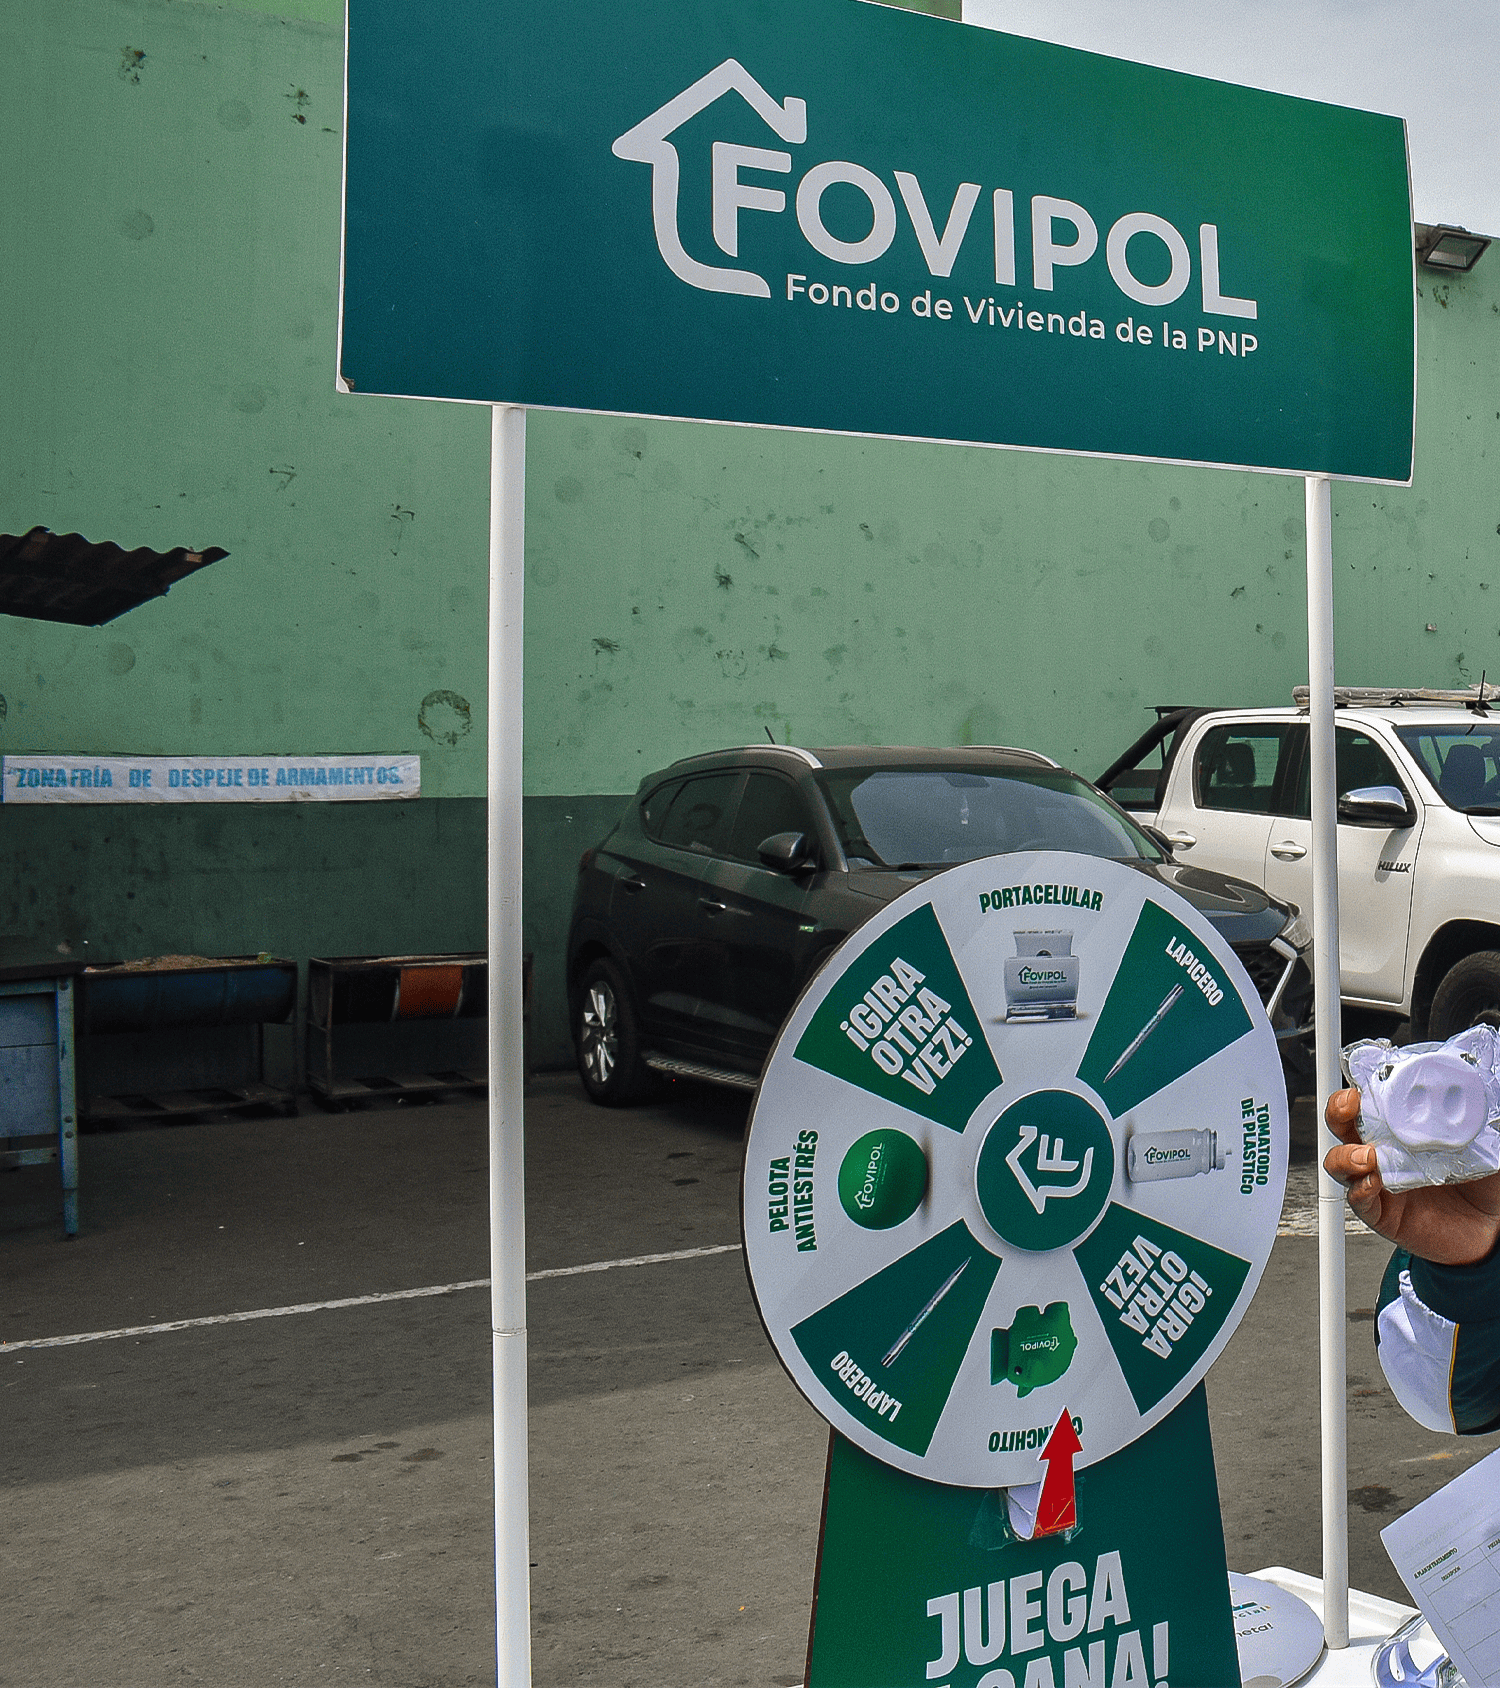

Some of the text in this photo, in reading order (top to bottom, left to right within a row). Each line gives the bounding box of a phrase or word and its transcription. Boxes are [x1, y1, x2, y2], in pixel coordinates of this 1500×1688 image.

[713, 141, 1258, 319] FOVIPOL
[786, 274, 1259, 358] Fondo de Vivienda de la PNP
[129, 769, 152, 787] DE
[168, 768, 243, 788] DESPEJE
[248, 768, 270, 786] DE
[979, 884, 1103, 914] PORTACELULAR
[1378, 861, 1411, 873] HILUX
[839, 957, 926, 1052] ¡GIRA
[1023, 971, 1067, 982] FOVIPOL
[1165, 935, 1224, 1006] LAPICERO
[871, 987, 951, 1075] OTRA
[901, 1016, 973, 1095] VEZ!
[1241, 1098, 1255, 1119] DE
[1256, 1103, 1270, 1186] TOMATODO
[793, 1130, 819, 1252] ANTIESTRÉS
[861, 1142, 883, 1202] FOVIPOL
[1150, 1148, 1191, 1161] FOVIPOL
[768, 1156, 790, 1233] PELOTA
[1100, 1235, 1162, 1310] VEZ!
[1119, 1251, 1188, 1334] OTRA
[1020, 1337, 1055, 1352] FOVIPOL
[1142, 1270, 1213, 1359] ¡GIRA
[830, 1351, 902, 1422] LAPICERO
[988, 1415, 1083, 1453] CNCHITO
[926, 1550, 1131, 1679] JUEGA
[975, 1621, 1169, 1688] NA!
